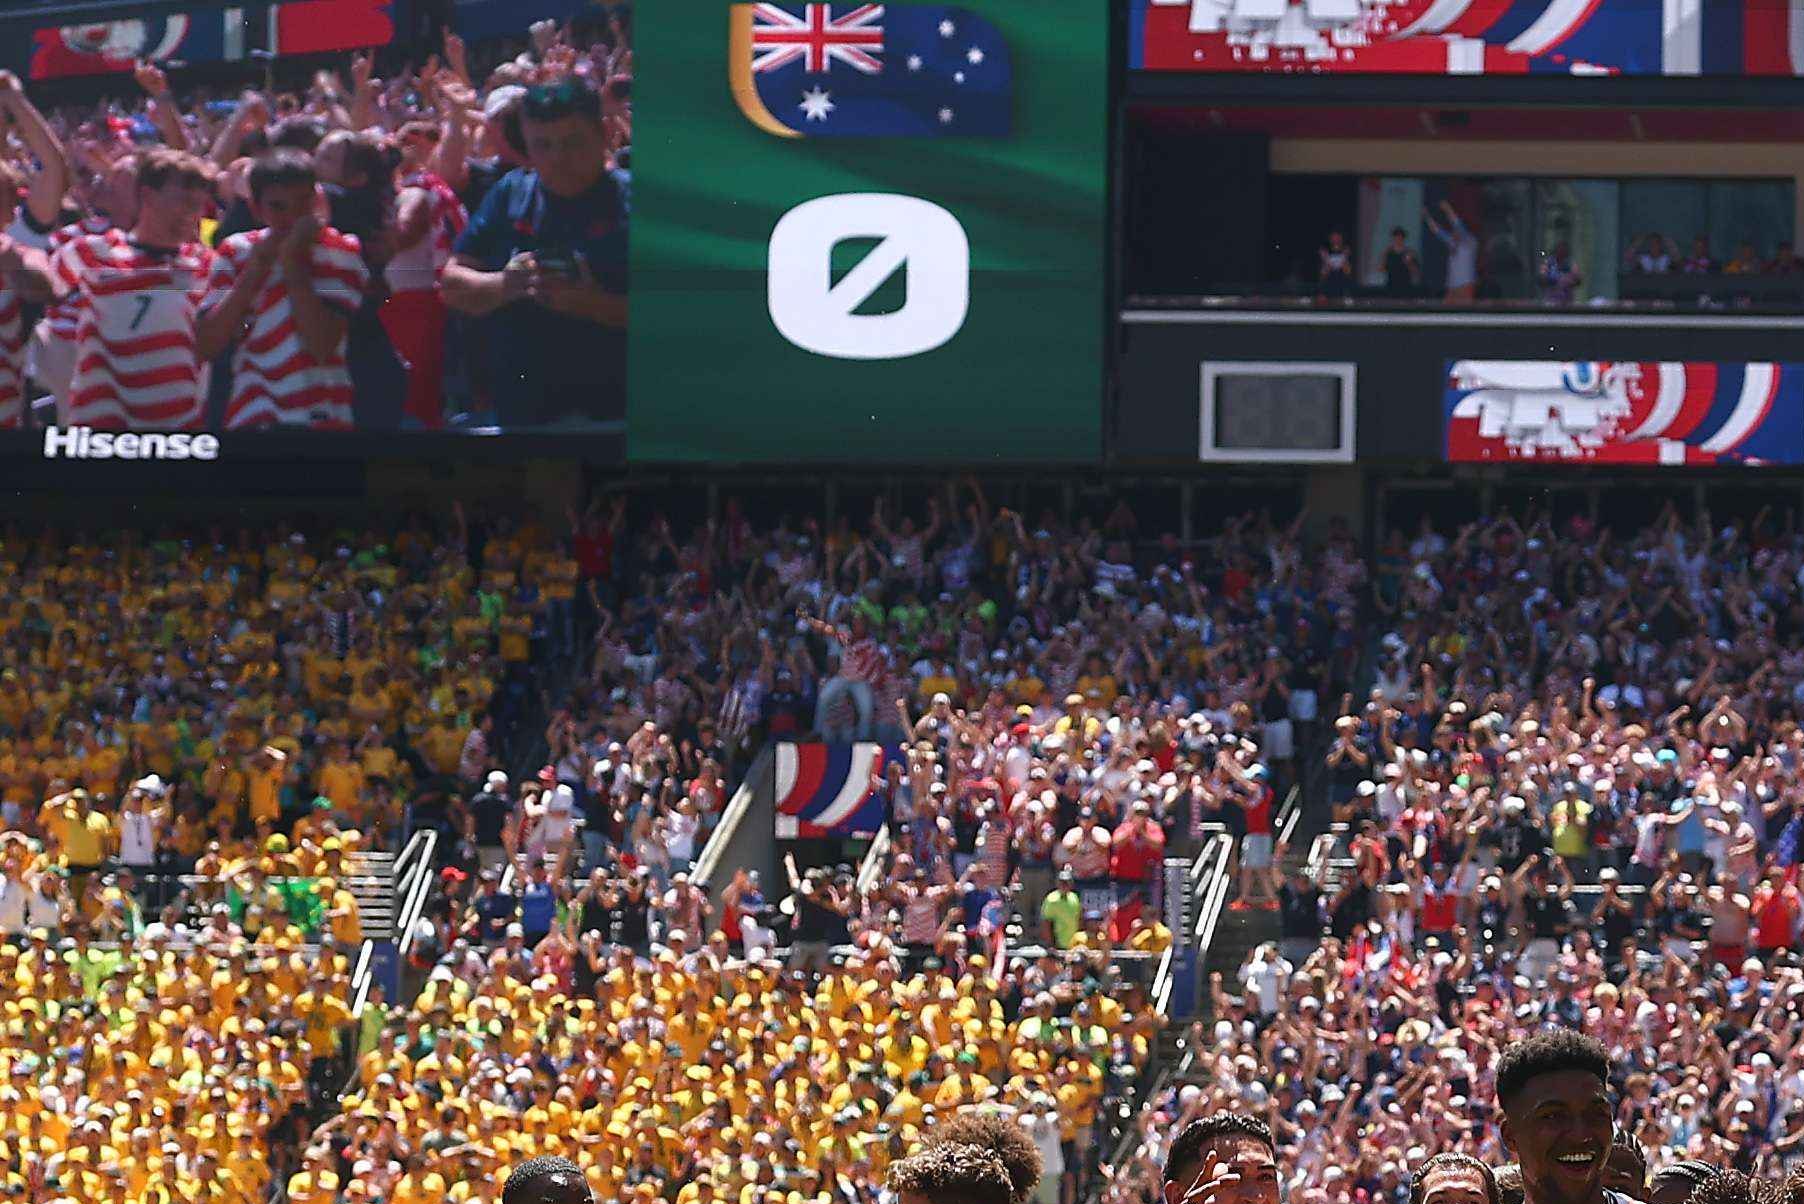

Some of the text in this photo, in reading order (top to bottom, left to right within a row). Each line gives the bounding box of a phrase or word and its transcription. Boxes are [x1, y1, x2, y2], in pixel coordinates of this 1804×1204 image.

[768, 193, 969, 359] 0
[129, 295, 151, 330] 7
[44, 425, 220, 461] Hisense
